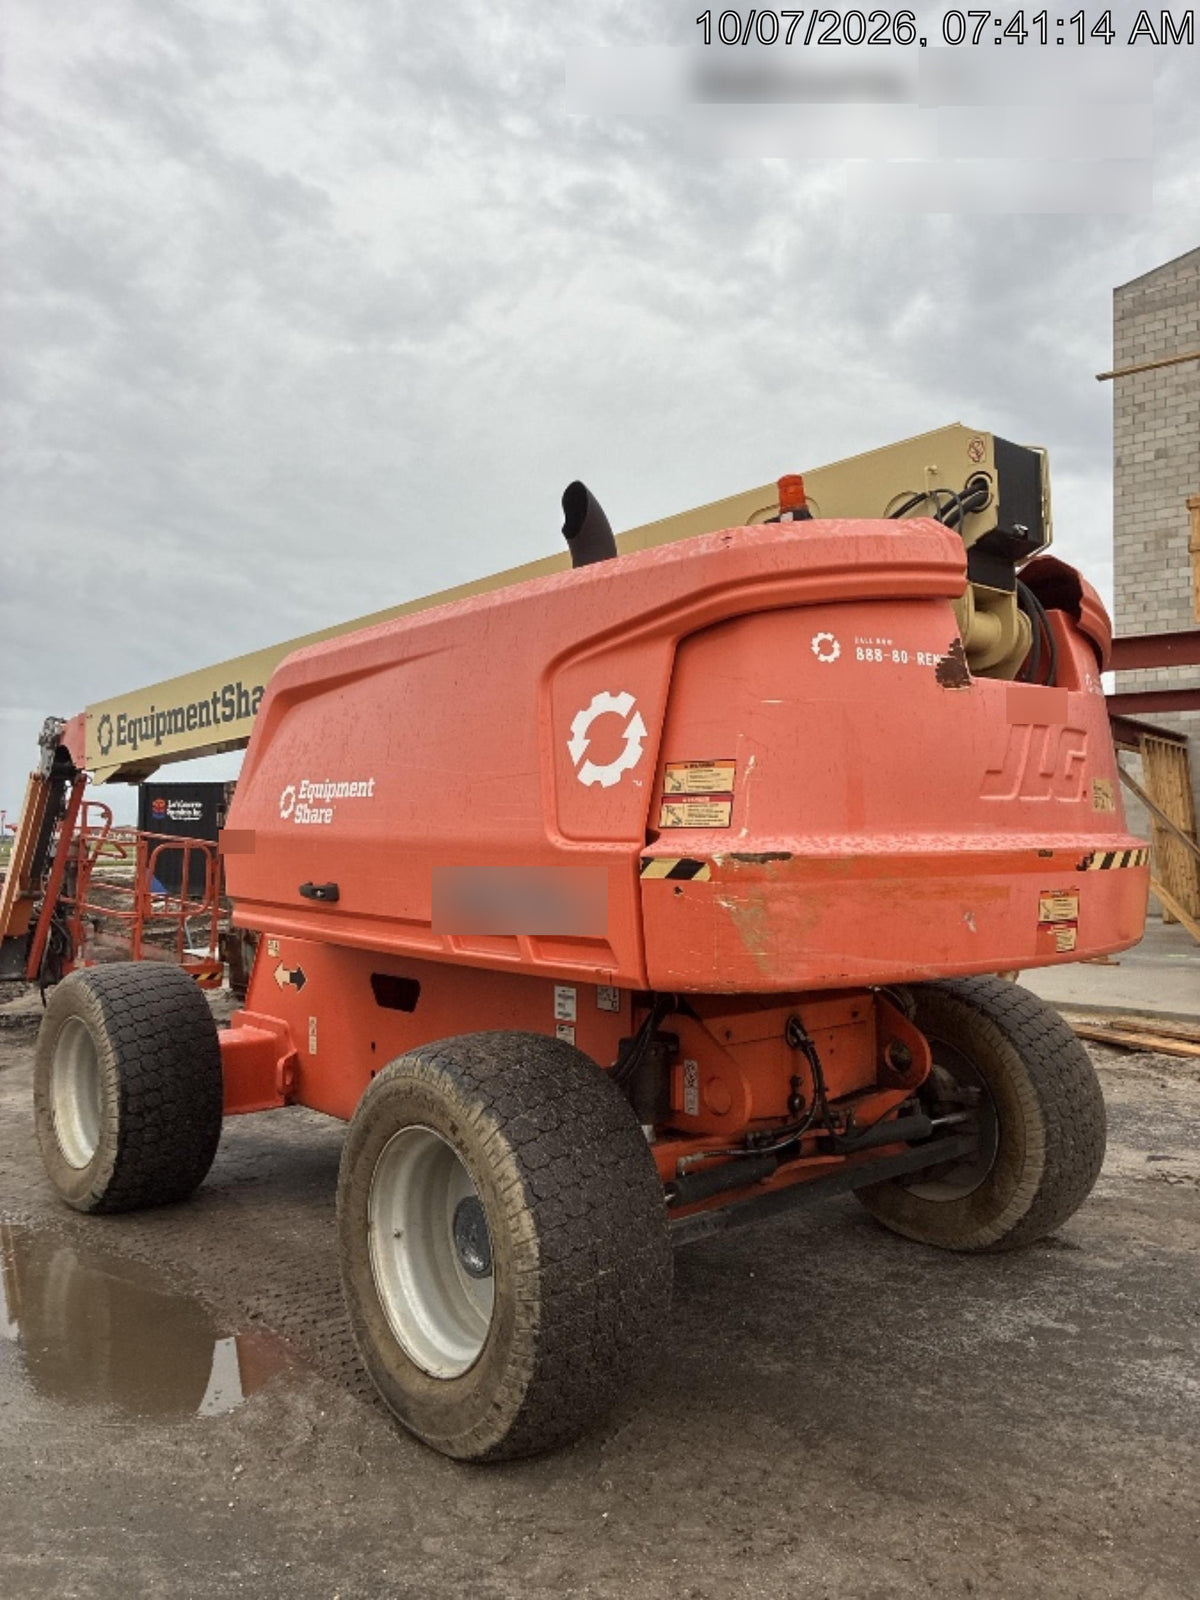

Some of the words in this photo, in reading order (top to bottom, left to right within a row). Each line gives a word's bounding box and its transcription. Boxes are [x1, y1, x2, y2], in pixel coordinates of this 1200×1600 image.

[116, 681, 266, 751] EquipmentSha
[979, 723, 1089, 803] JLG
[294, 803, 333, 824] Share
[298, 778, 376, 804] Equipment
